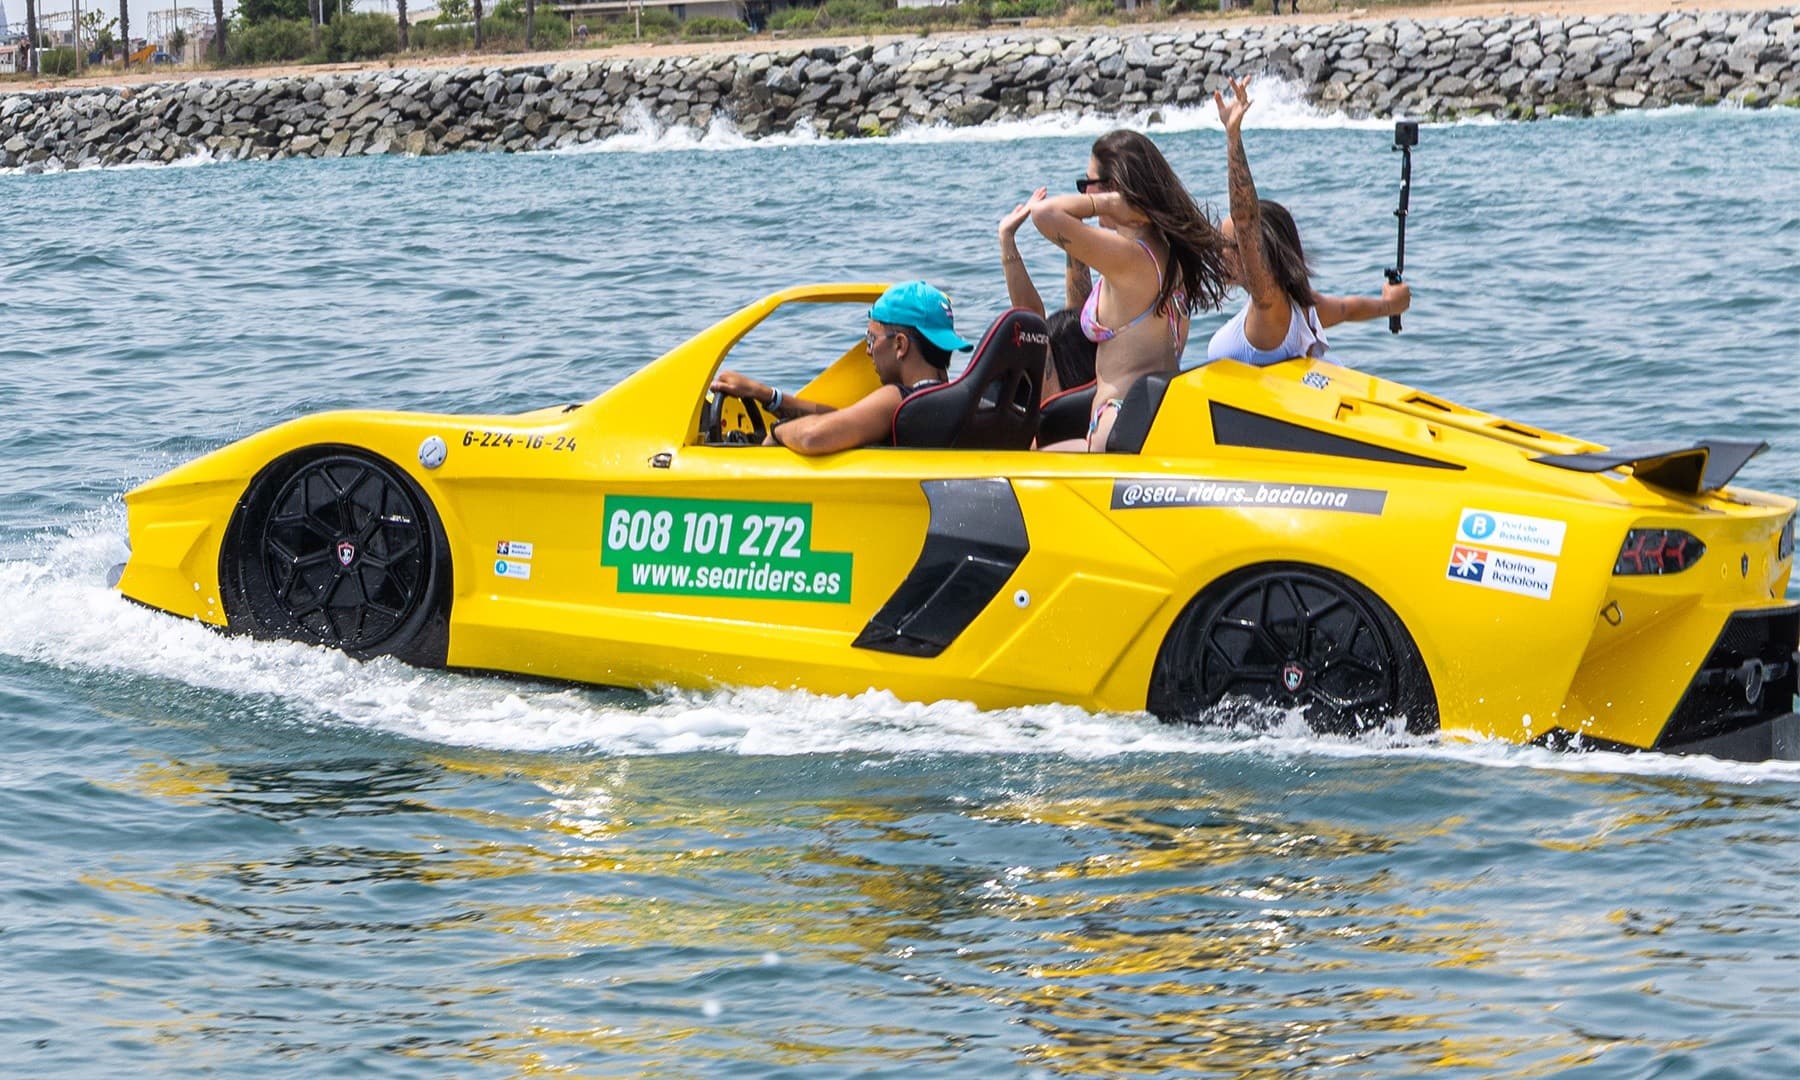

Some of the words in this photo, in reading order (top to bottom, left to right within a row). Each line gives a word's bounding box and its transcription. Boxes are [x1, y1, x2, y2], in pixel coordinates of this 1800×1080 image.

[463, 431, 576, 451] 6-224-16-24
[1122, 483, 1348, 507] @sea_riders_badalona
[607, 509, 673, 552] 608
[683, 512, 733, 555] 101
[738, 515, 805, 558] 272
[1499, 531, 1550, 546] Badalona
[1495, 558, 1535, 575] Marina
[632, 561, 841, 595] www.seariders.es
[1492, 571, 1548, 591] Badalona
